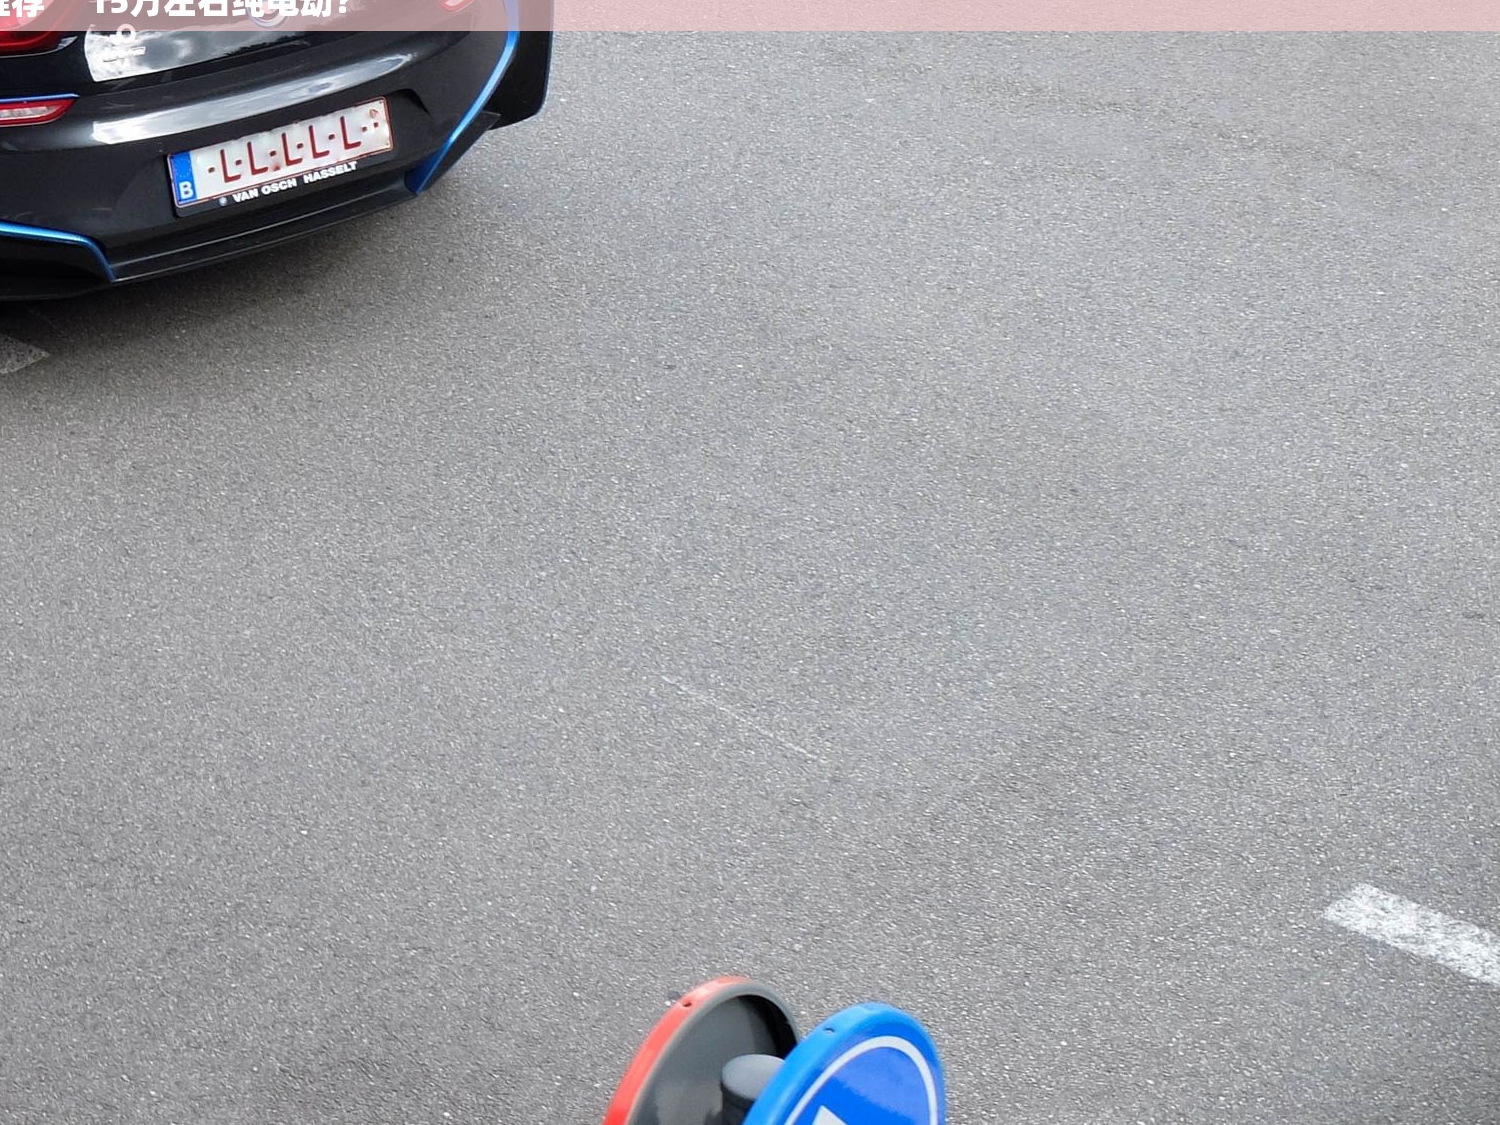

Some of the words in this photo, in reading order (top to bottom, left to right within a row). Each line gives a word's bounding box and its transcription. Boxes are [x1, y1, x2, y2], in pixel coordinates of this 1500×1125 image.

[179, 181, 195, 200] B
[232, 188, 259, 203] VAN
[261, 178, 297, 195] OSCH
[303, 161, 357, 184] HASSELT
